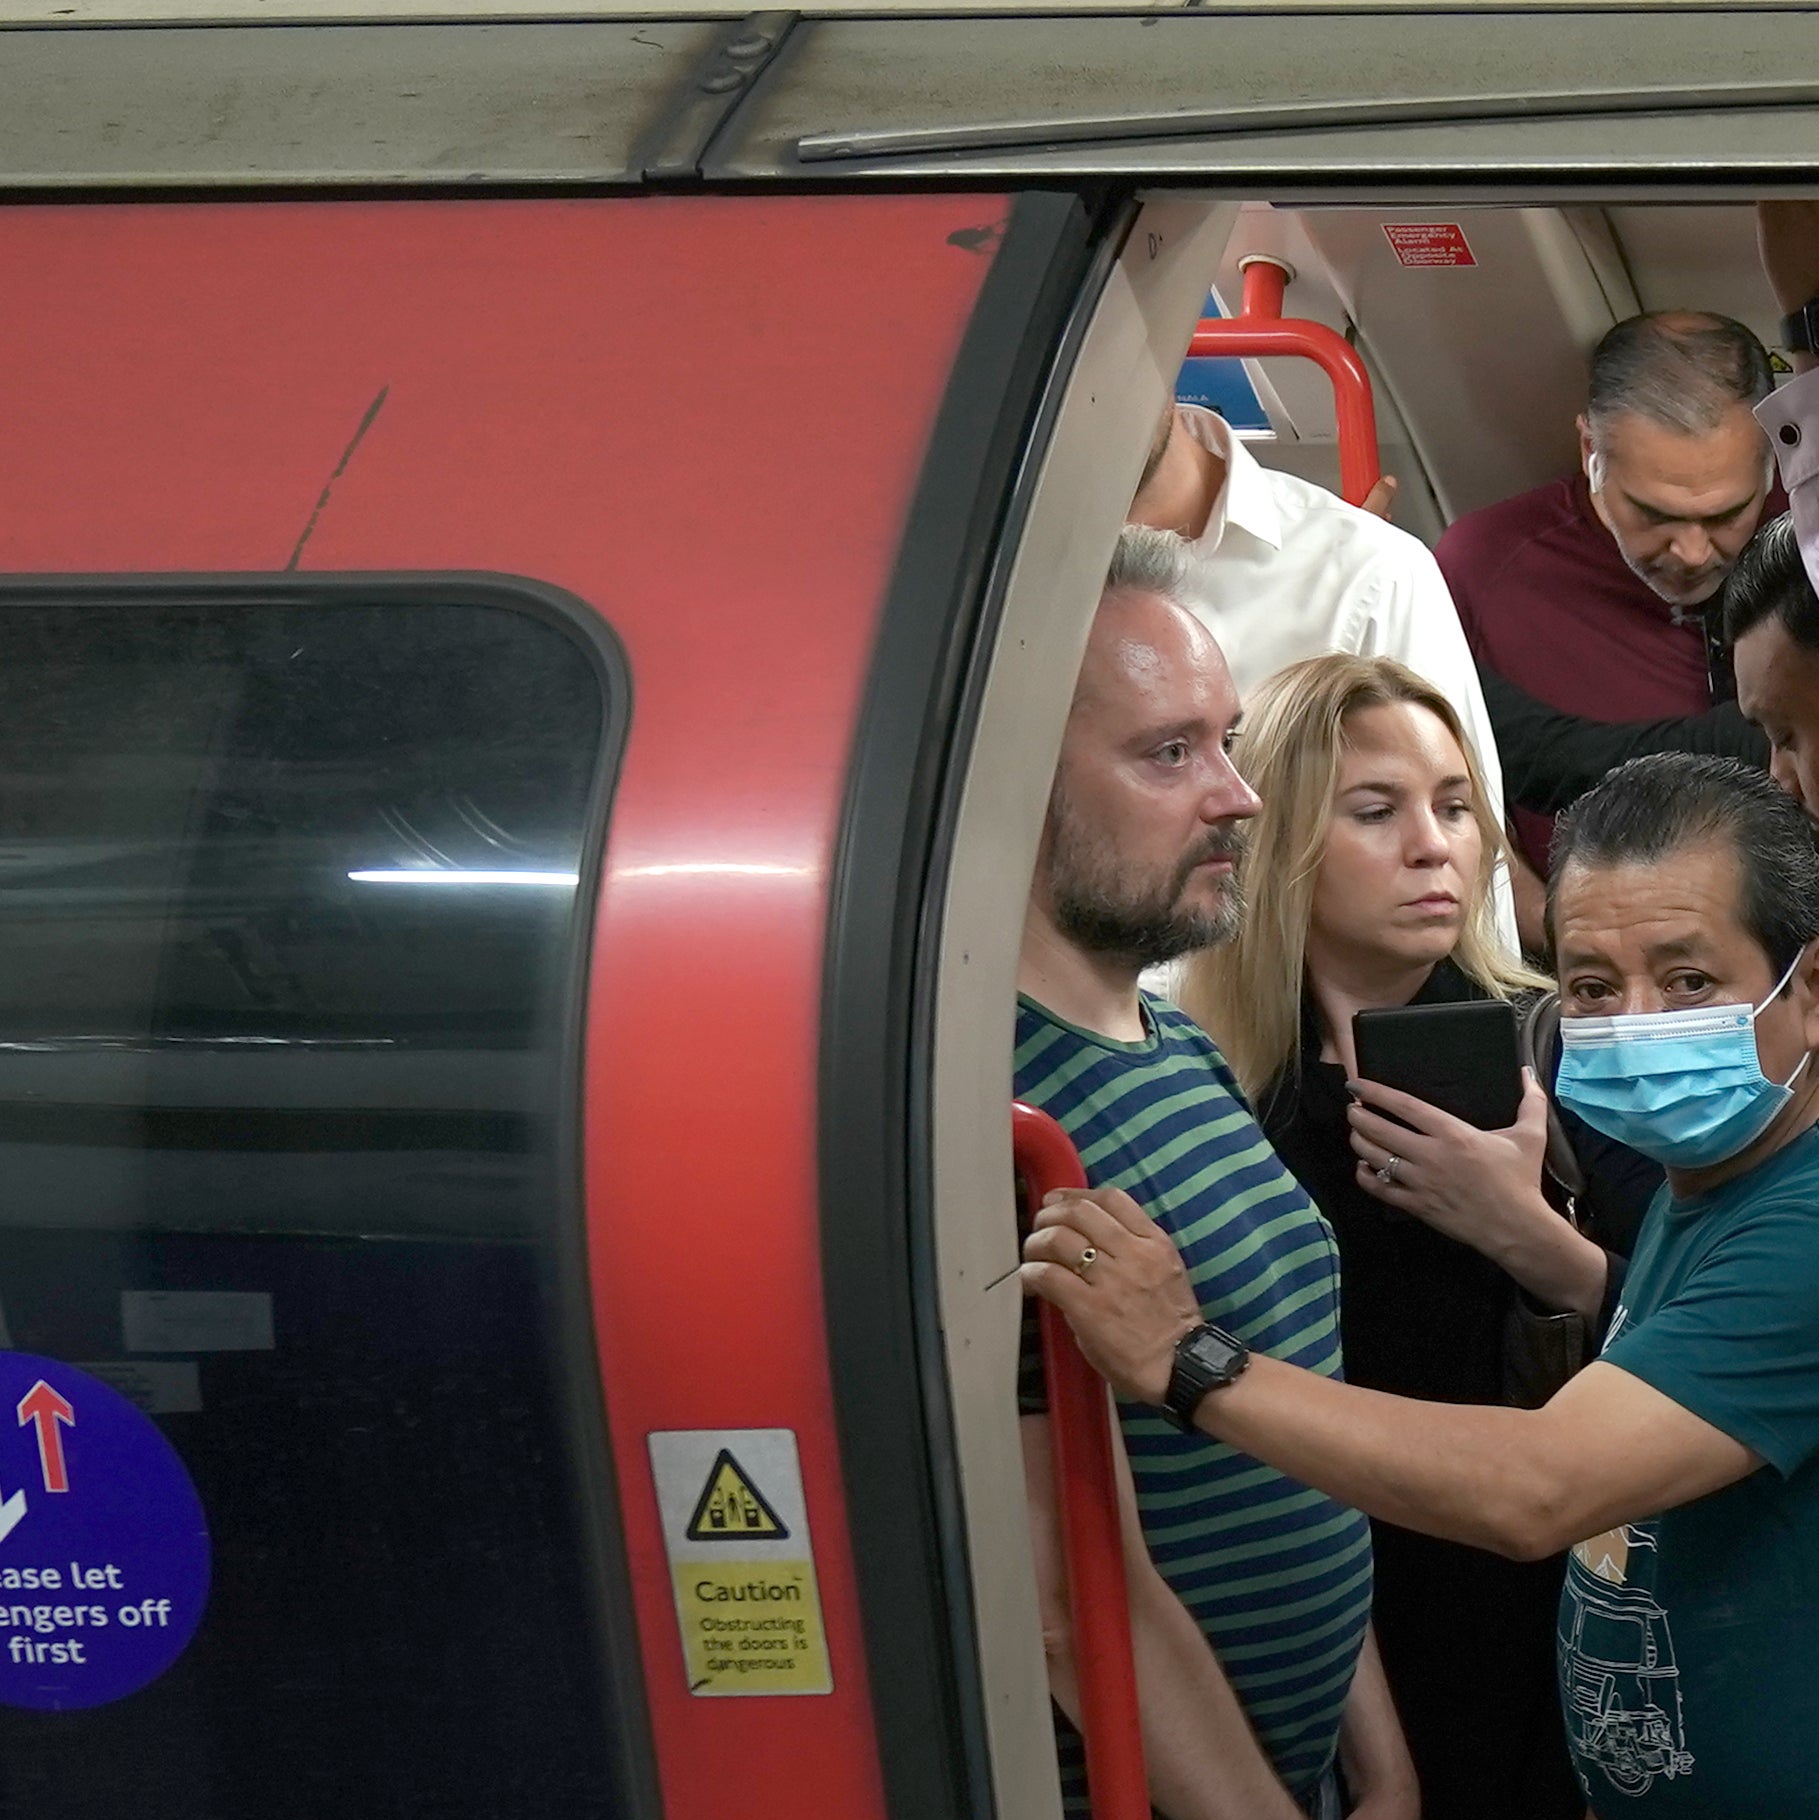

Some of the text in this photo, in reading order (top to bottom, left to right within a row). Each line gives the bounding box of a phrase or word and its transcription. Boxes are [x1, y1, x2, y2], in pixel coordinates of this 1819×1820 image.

[0, 1561, 125, 1590] ase let
[695, 1580, 801, 1602] Caution
[117, 1598, 173, 1628] off
[700, 1616, 807, 1634] Obstructing
[7, 1635, 88, 1665] first
[703, 1634, 808, 1652] the doors is
